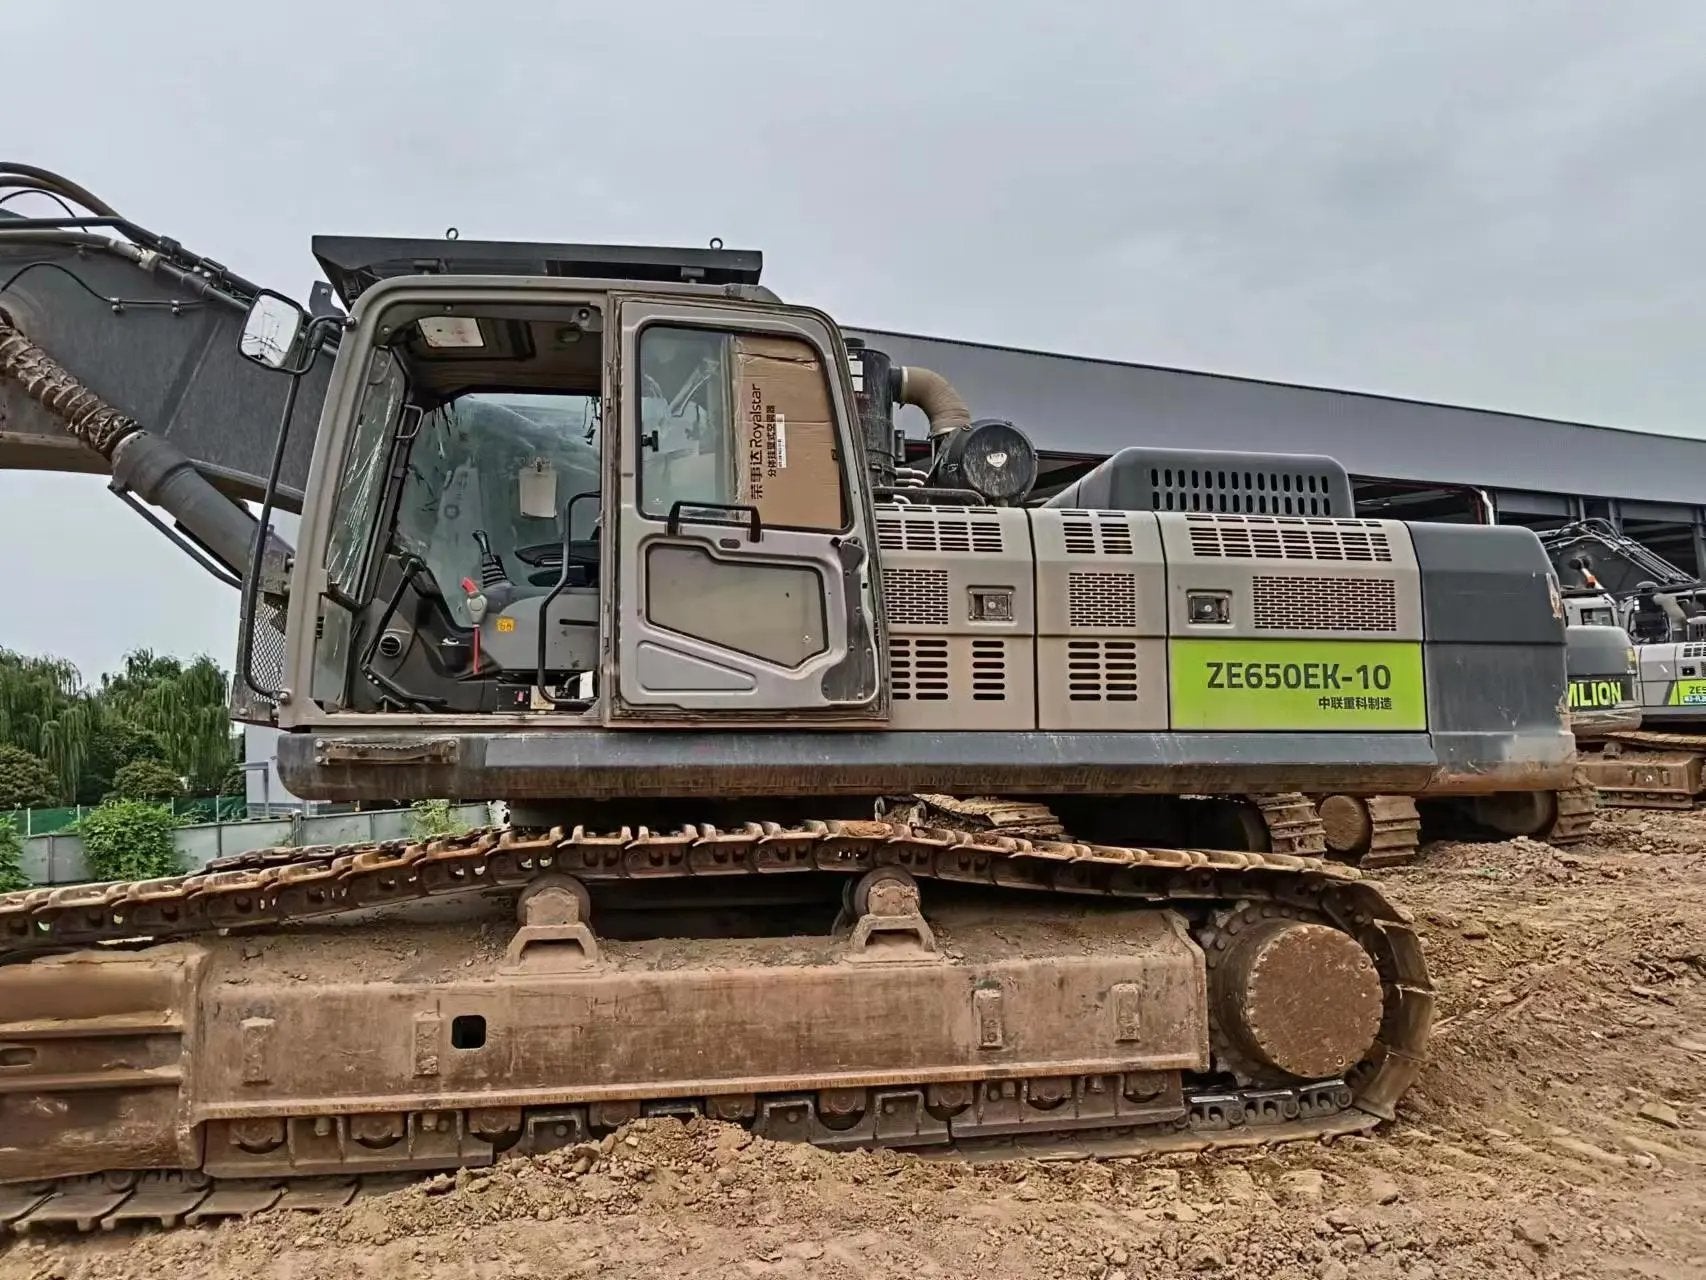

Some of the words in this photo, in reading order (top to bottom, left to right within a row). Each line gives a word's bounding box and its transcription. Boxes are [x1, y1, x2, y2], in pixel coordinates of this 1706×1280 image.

[750, 384, 765, 447] Royalstar
[750, 449, 763, 500] 荣事达
[1206, 662, 1392, 690] ZE650EK-10
[1318, 697, 1392, 710] 中联重科制造
